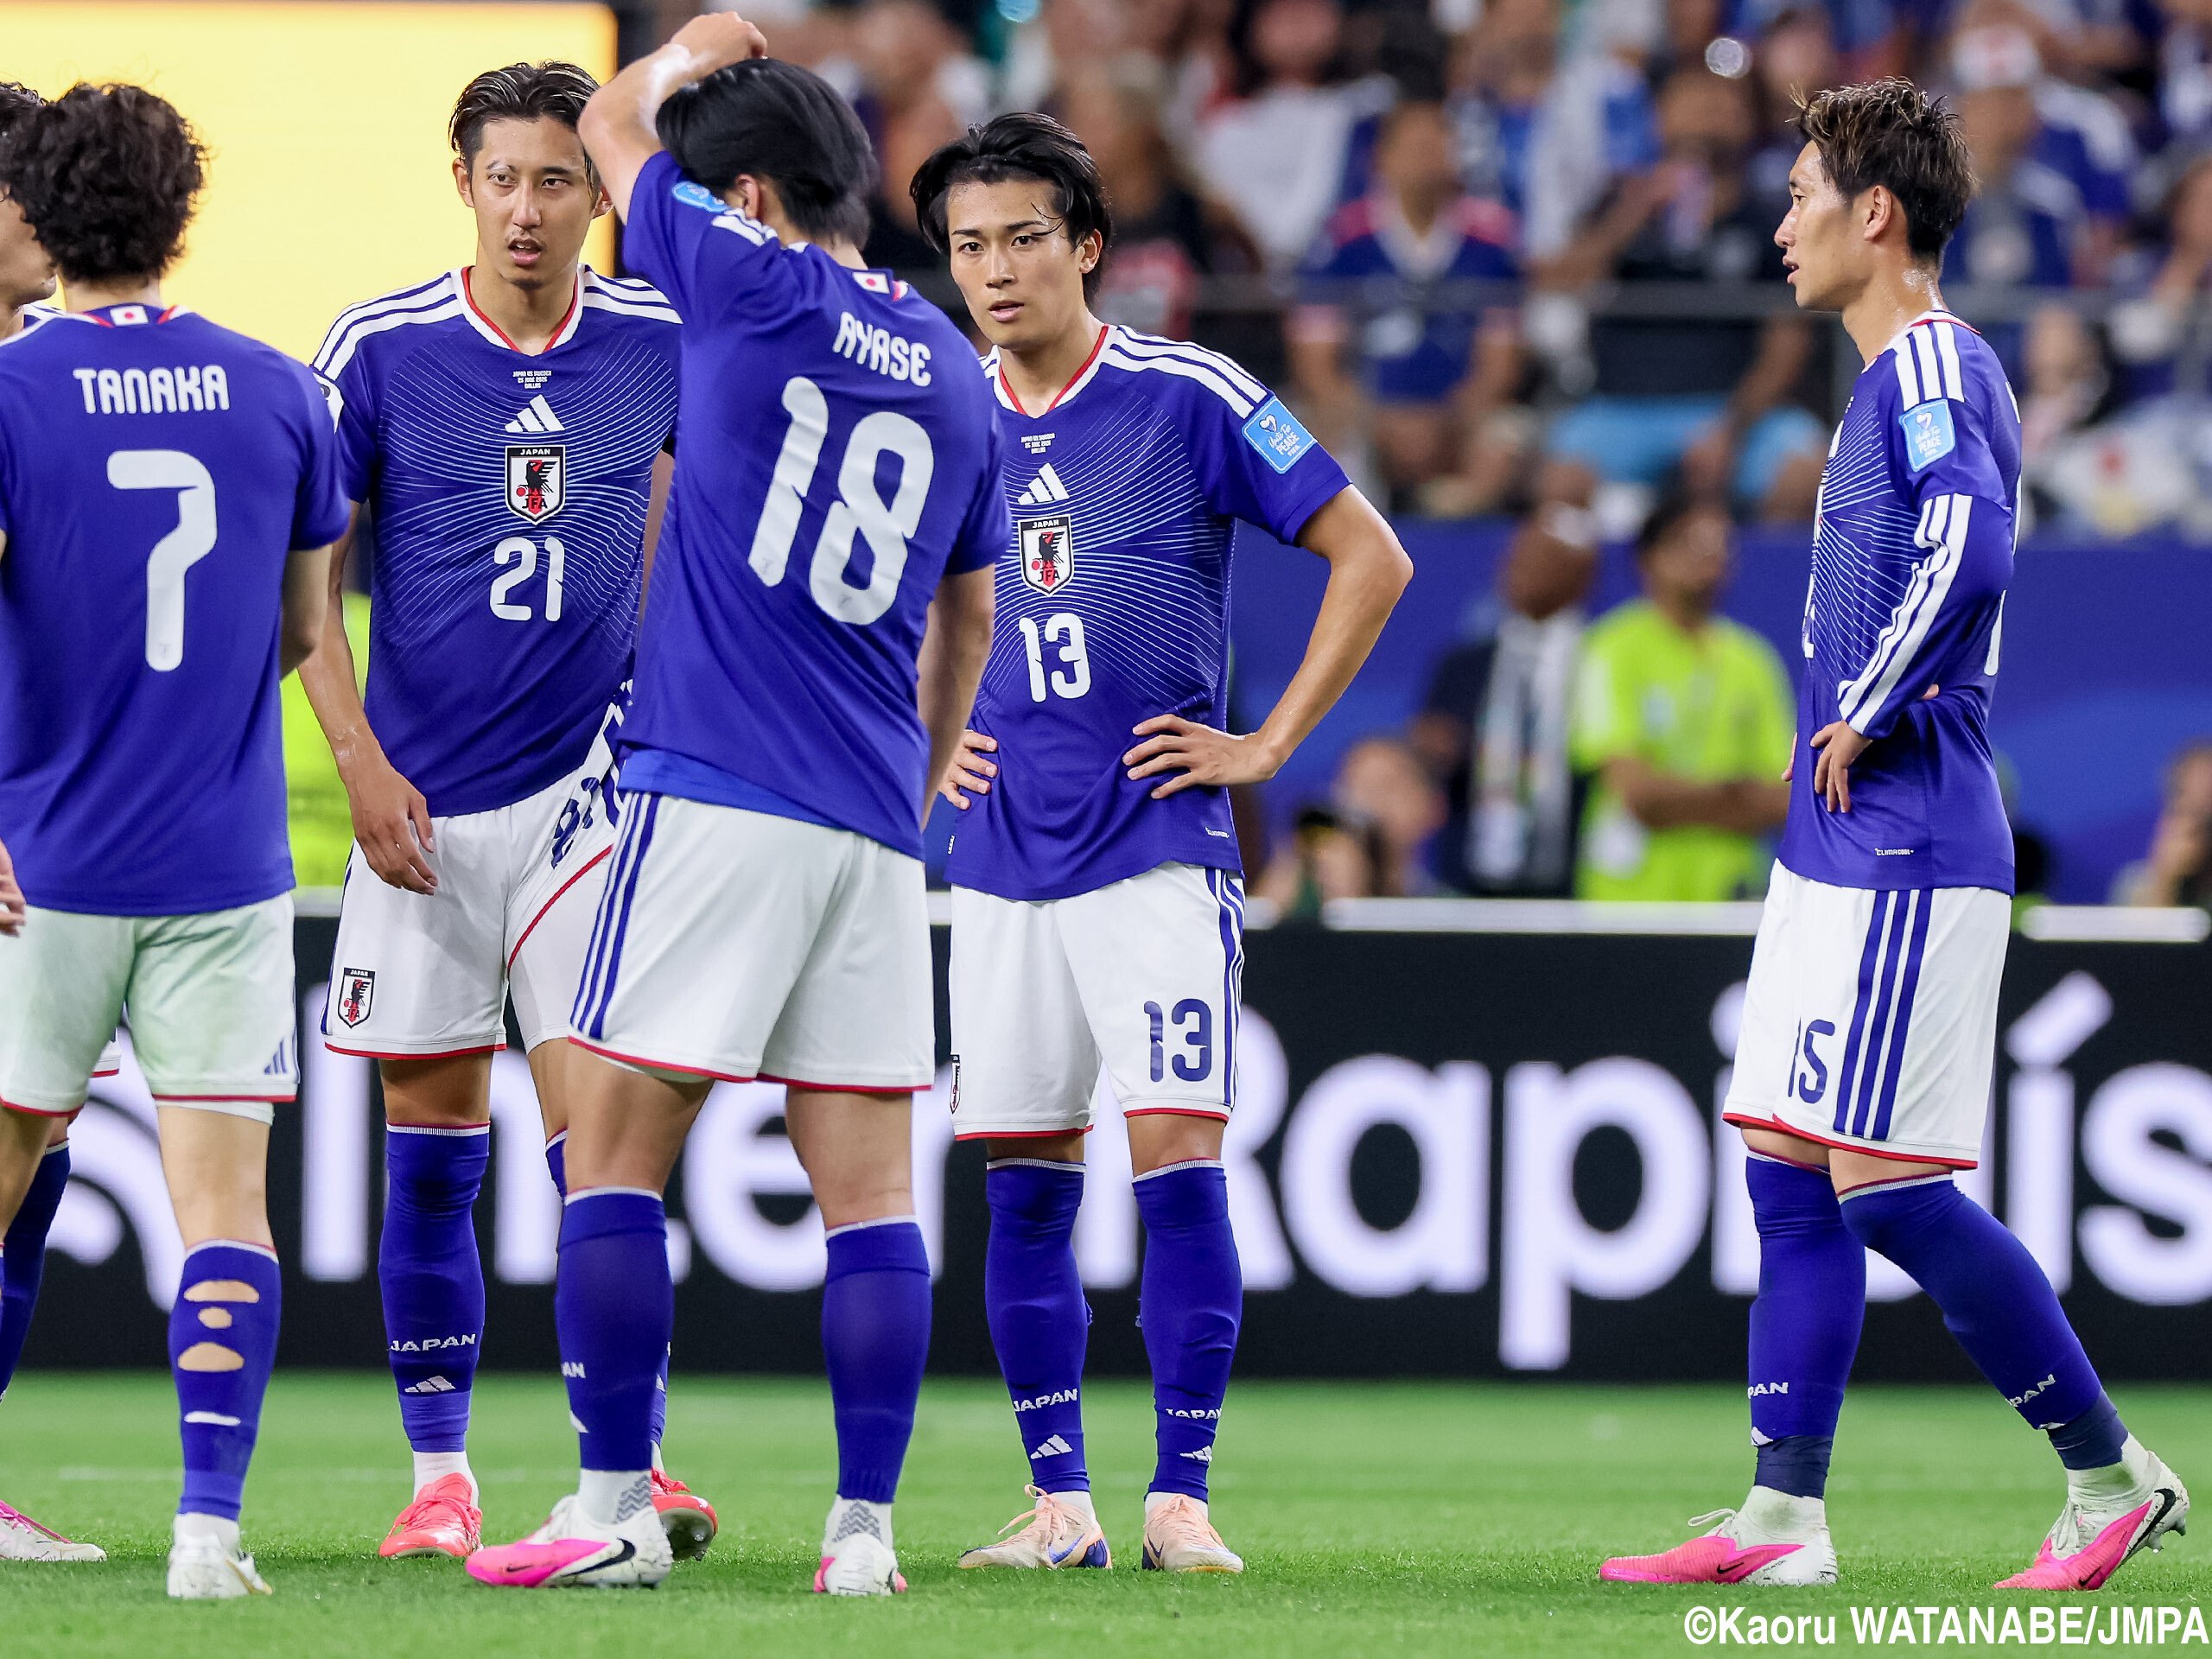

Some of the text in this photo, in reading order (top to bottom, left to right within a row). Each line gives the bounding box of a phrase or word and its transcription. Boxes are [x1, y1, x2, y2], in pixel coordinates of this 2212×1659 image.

[832, 311, 932, 387] AYASE
[73, 365, 230, 414] TANAKA
[1275, 432, 1300, 455] PEACE
[522, 498, 548, 510] JFA
[747, 376, 934, 625] 18
[1032, 519, 1059, 529] JAPAN
[106, 449, 217, 671] 7
[490, 537, 565, 621] 21
[1038, 569, 1060, 582] JFA
[1019, 613, 1091, 702] 13
[1144, 998, 1211, 1082] 13
[391, 1333, 476, 1351] JAPAN
[1013, 1388, 1078, 1412] JAPAN
[2005, 1373, 2056, 1408] PAN
